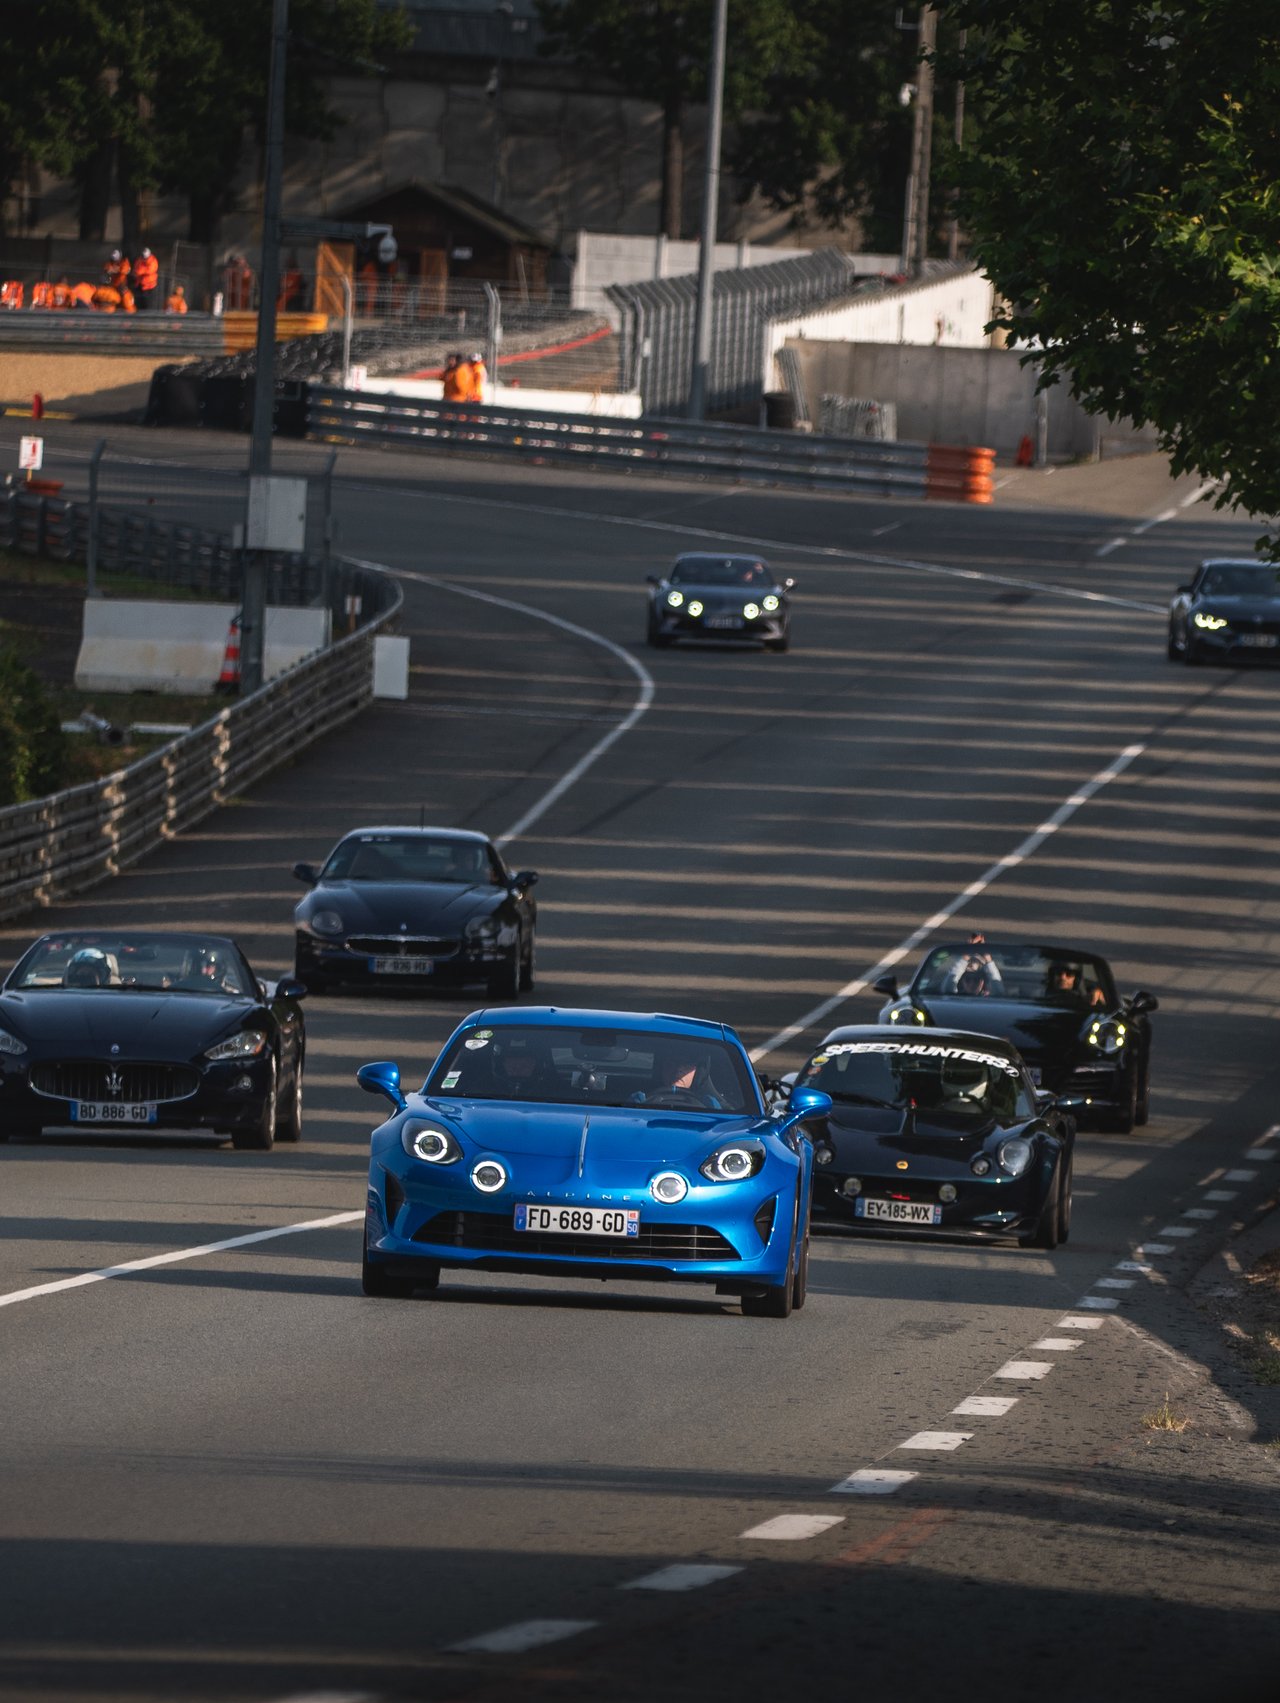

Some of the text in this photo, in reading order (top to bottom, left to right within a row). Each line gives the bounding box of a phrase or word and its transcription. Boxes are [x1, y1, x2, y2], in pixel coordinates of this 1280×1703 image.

[824, 1042, 1011, 1070] SPEEDHUNTERS
[527, 1190, 632, 1202] ALPINE
[527, 1207, 625, 1233] FD-689-GD
[867, 1201, 931, 1221] EY-185-WX
